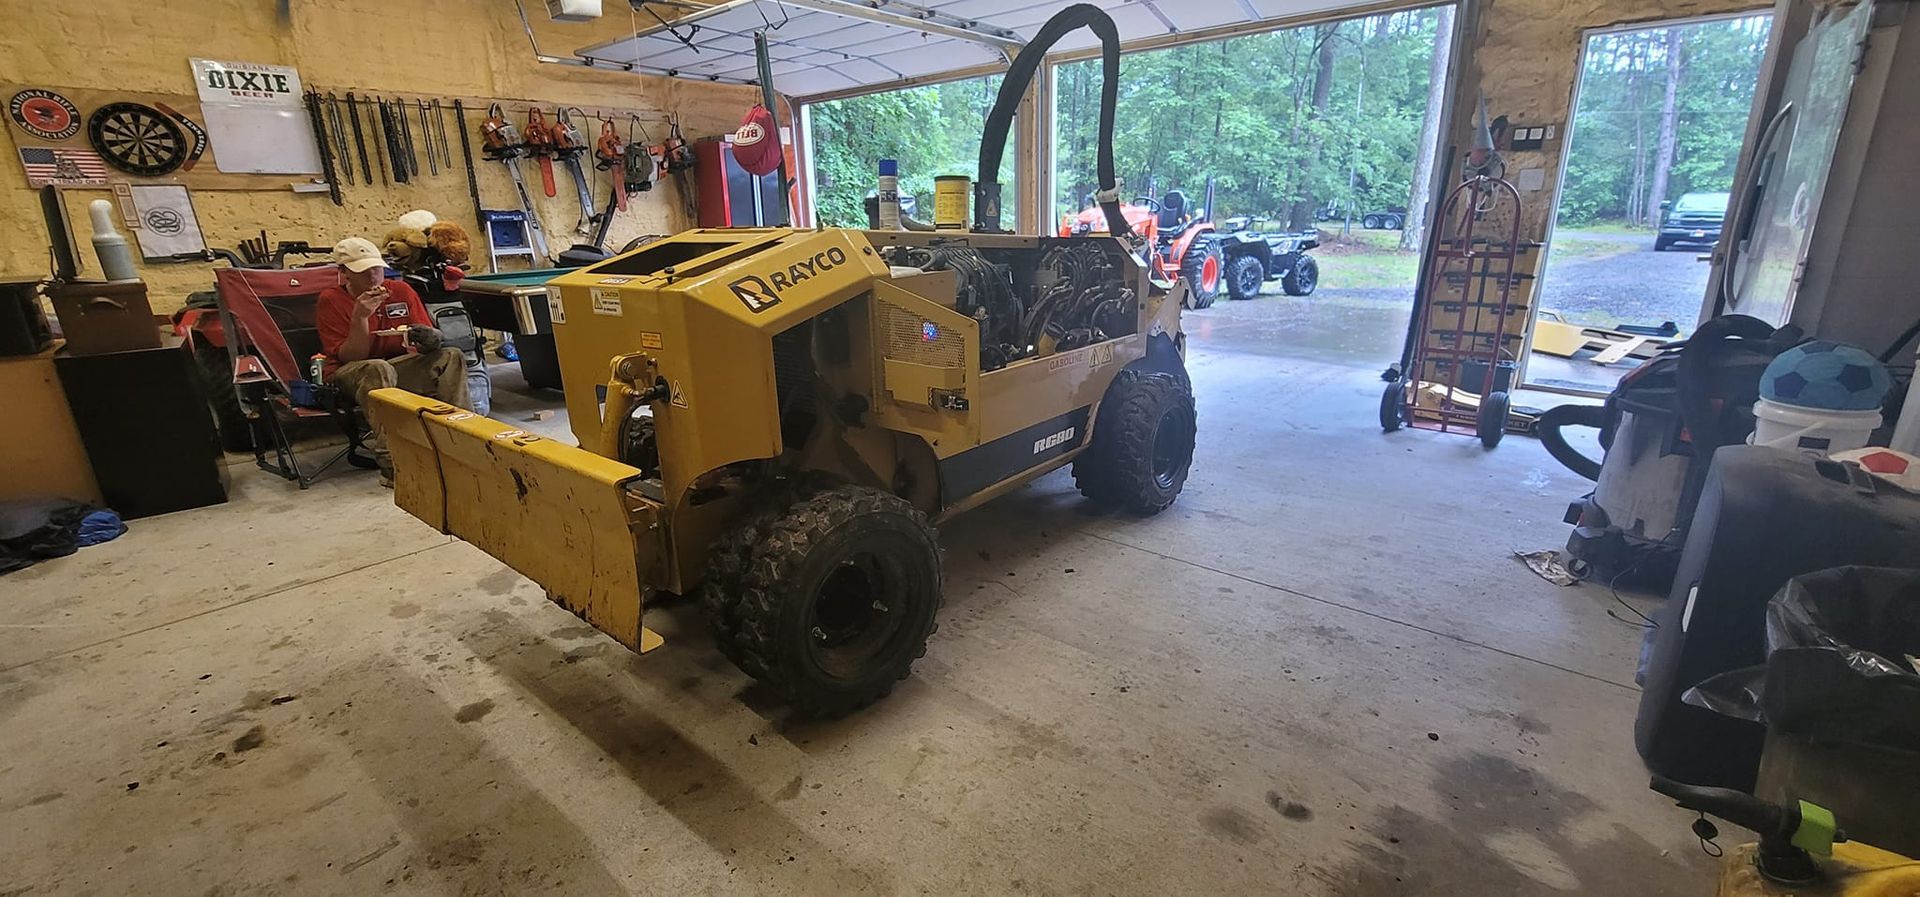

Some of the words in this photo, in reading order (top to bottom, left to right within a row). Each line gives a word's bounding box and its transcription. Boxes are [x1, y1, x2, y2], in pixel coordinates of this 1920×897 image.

[223, 62, 270, 72] OUISIANA
[207, 70, 290, 93] DIXIE
[11, 90, 50, 114] NATIONAL
[53, 95, 79, 116] RIFLE
[230, 90, 274, 99] BEER
[19, 121, 79, 139] ASSOCIATION
[182, 117, 205, 155] TENNESSEE
[769, 247, 847, 292] RAYCO
[1033, 426, 1075, 455] RG80
